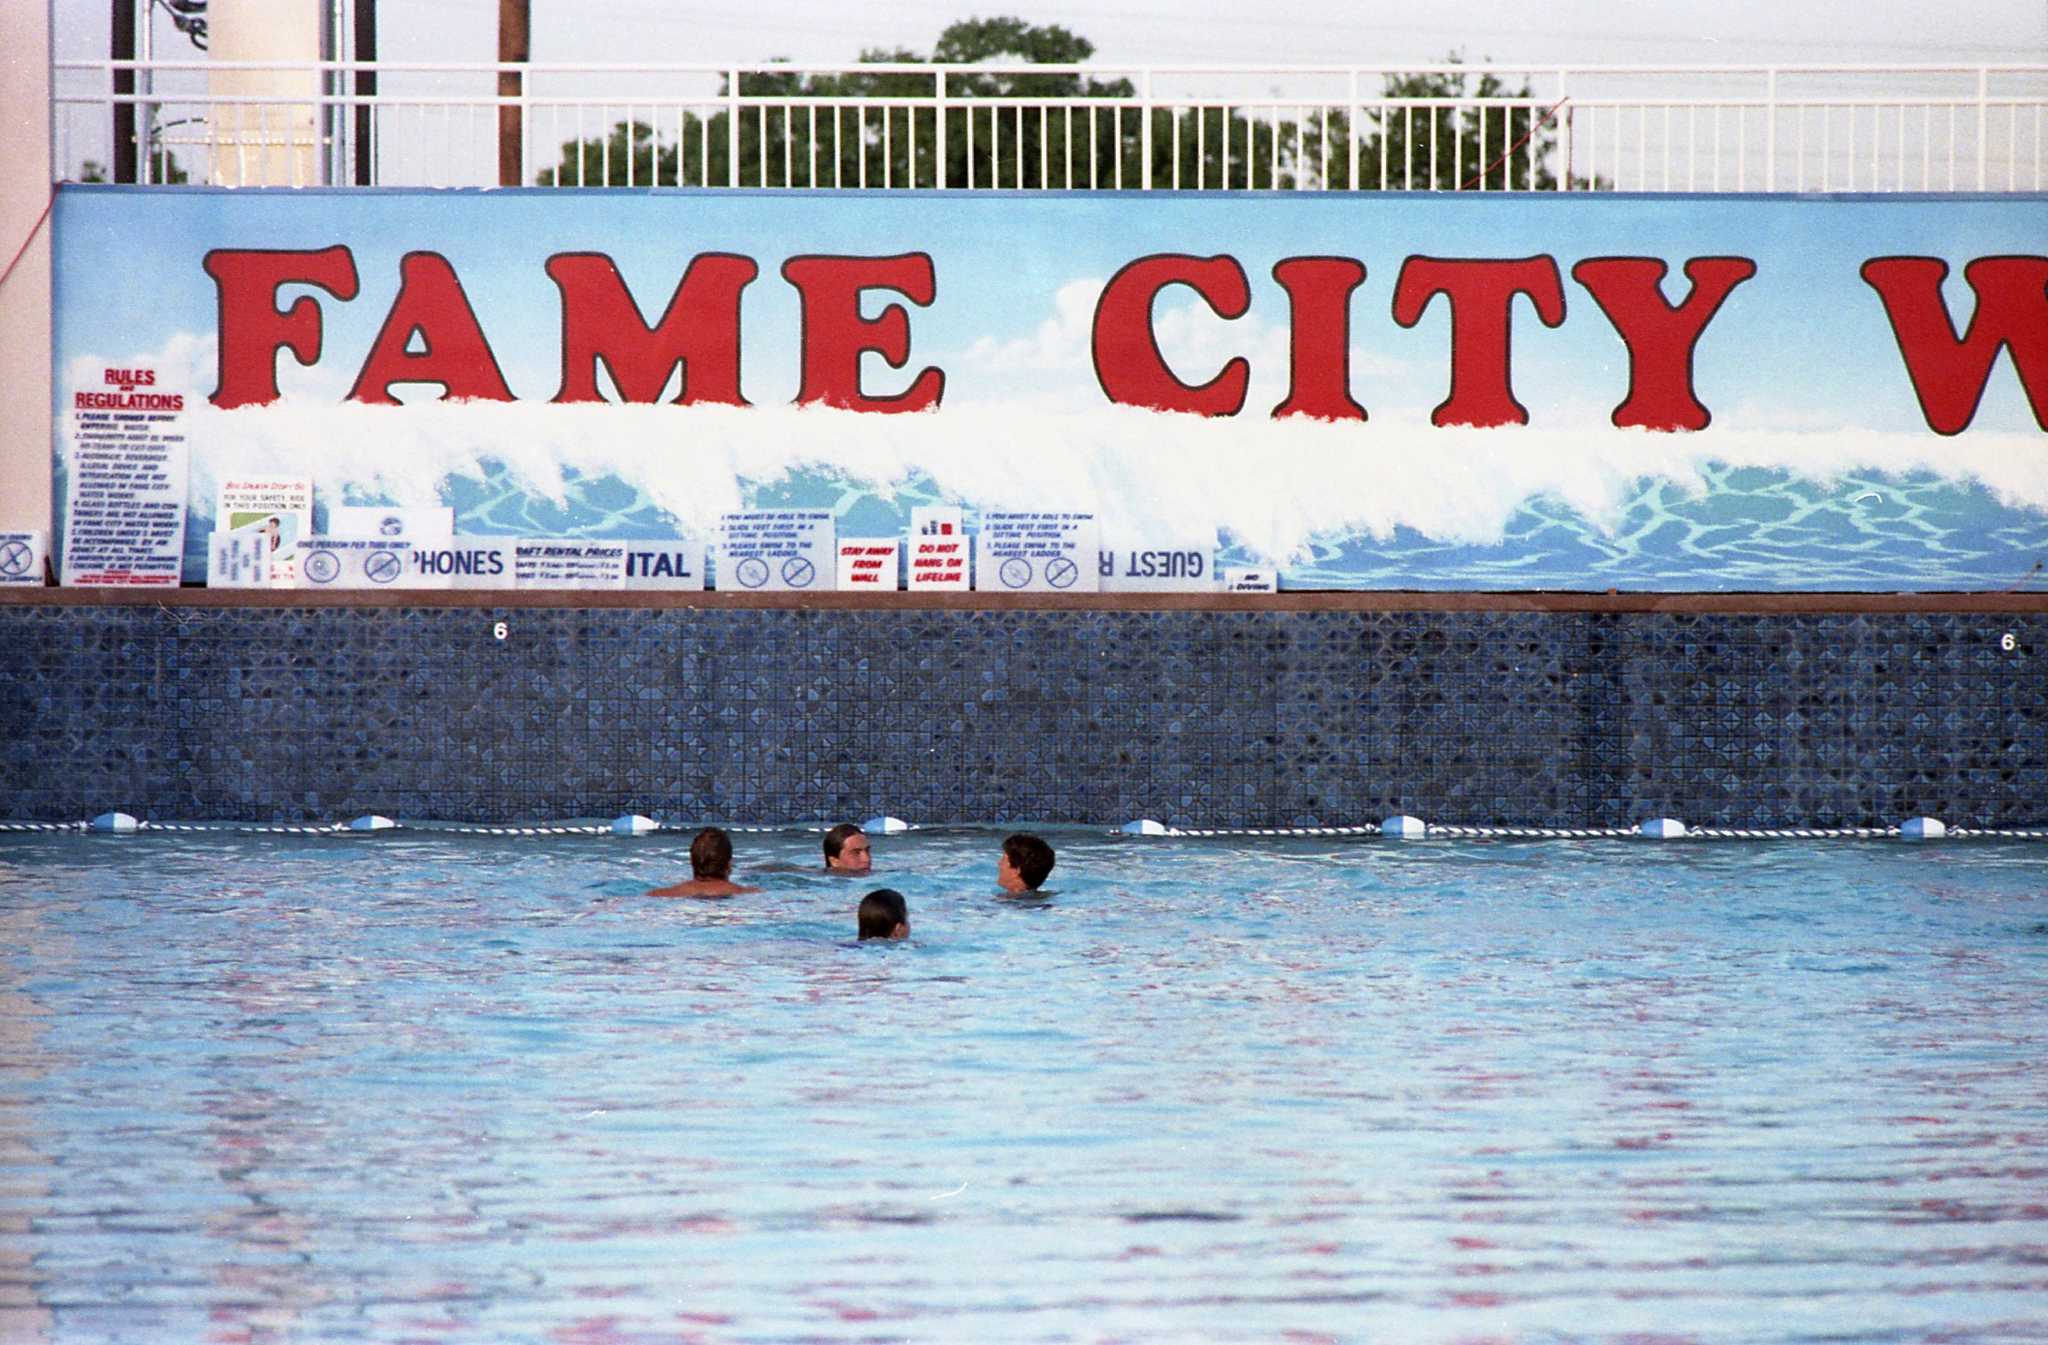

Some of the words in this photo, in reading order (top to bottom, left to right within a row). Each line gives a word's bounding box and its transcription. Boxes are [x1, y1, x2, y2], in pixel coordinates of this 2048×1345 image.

[203, 245, 945, 413] FAME
[1091, 253, 1757, 430] CITY
[104, 368, 156, 386] RULES
[74, 392, 184, 410] REGULATIONS
[544, 547, 581, 557] RENTAL
[583, 548, 623, 557] PRICES
[840, 547, 864, 555] STAY
[865, 547, 894, 555] AWAY
[918, 544, 935, 553] DO
[936, 544, 959, 553] NOT
[852, 560, 882, 568] FROM
[914, 558, 943, 567] HANG
[946, 558, 963, 567] ON
[1126, 552, 1204, 577] GUEST
[851, 574, 879, 582] WALL
[915, 573, 962, 582] LIFELINE
[494, 622, 508, 640] 6
[2001, 633, 2015, 651] 6
